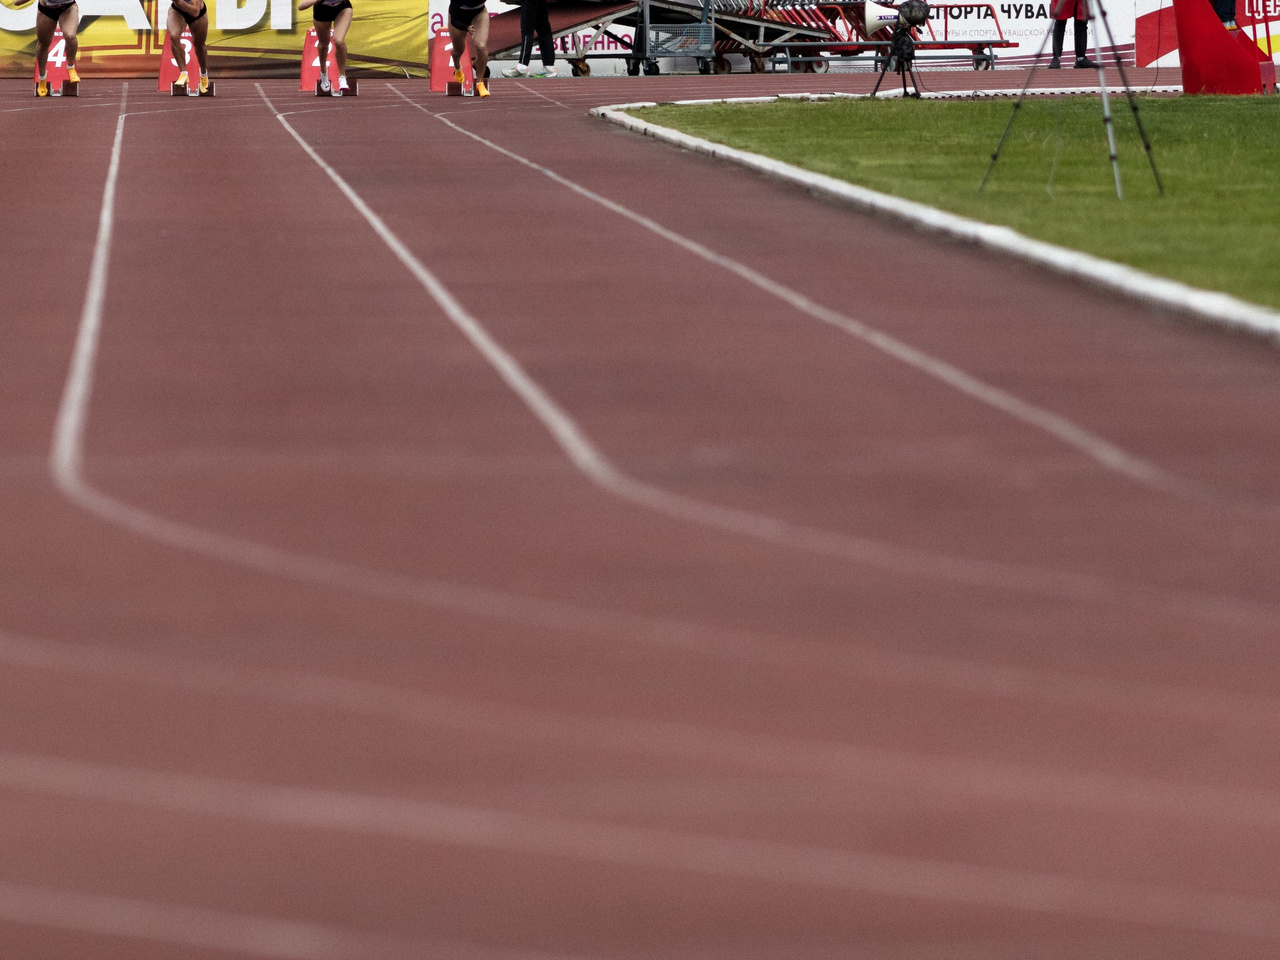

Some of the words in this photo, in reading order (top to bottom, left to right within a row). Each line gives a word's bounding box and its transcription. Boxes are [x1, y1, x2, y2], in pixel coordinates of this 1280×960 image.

[1001, 4, 1052, 19] ЧУВА
[969, 29, 997, 37] СПОРТА
[47, 38, 67, 68] 4
[170, 38, 192, 67] 3
